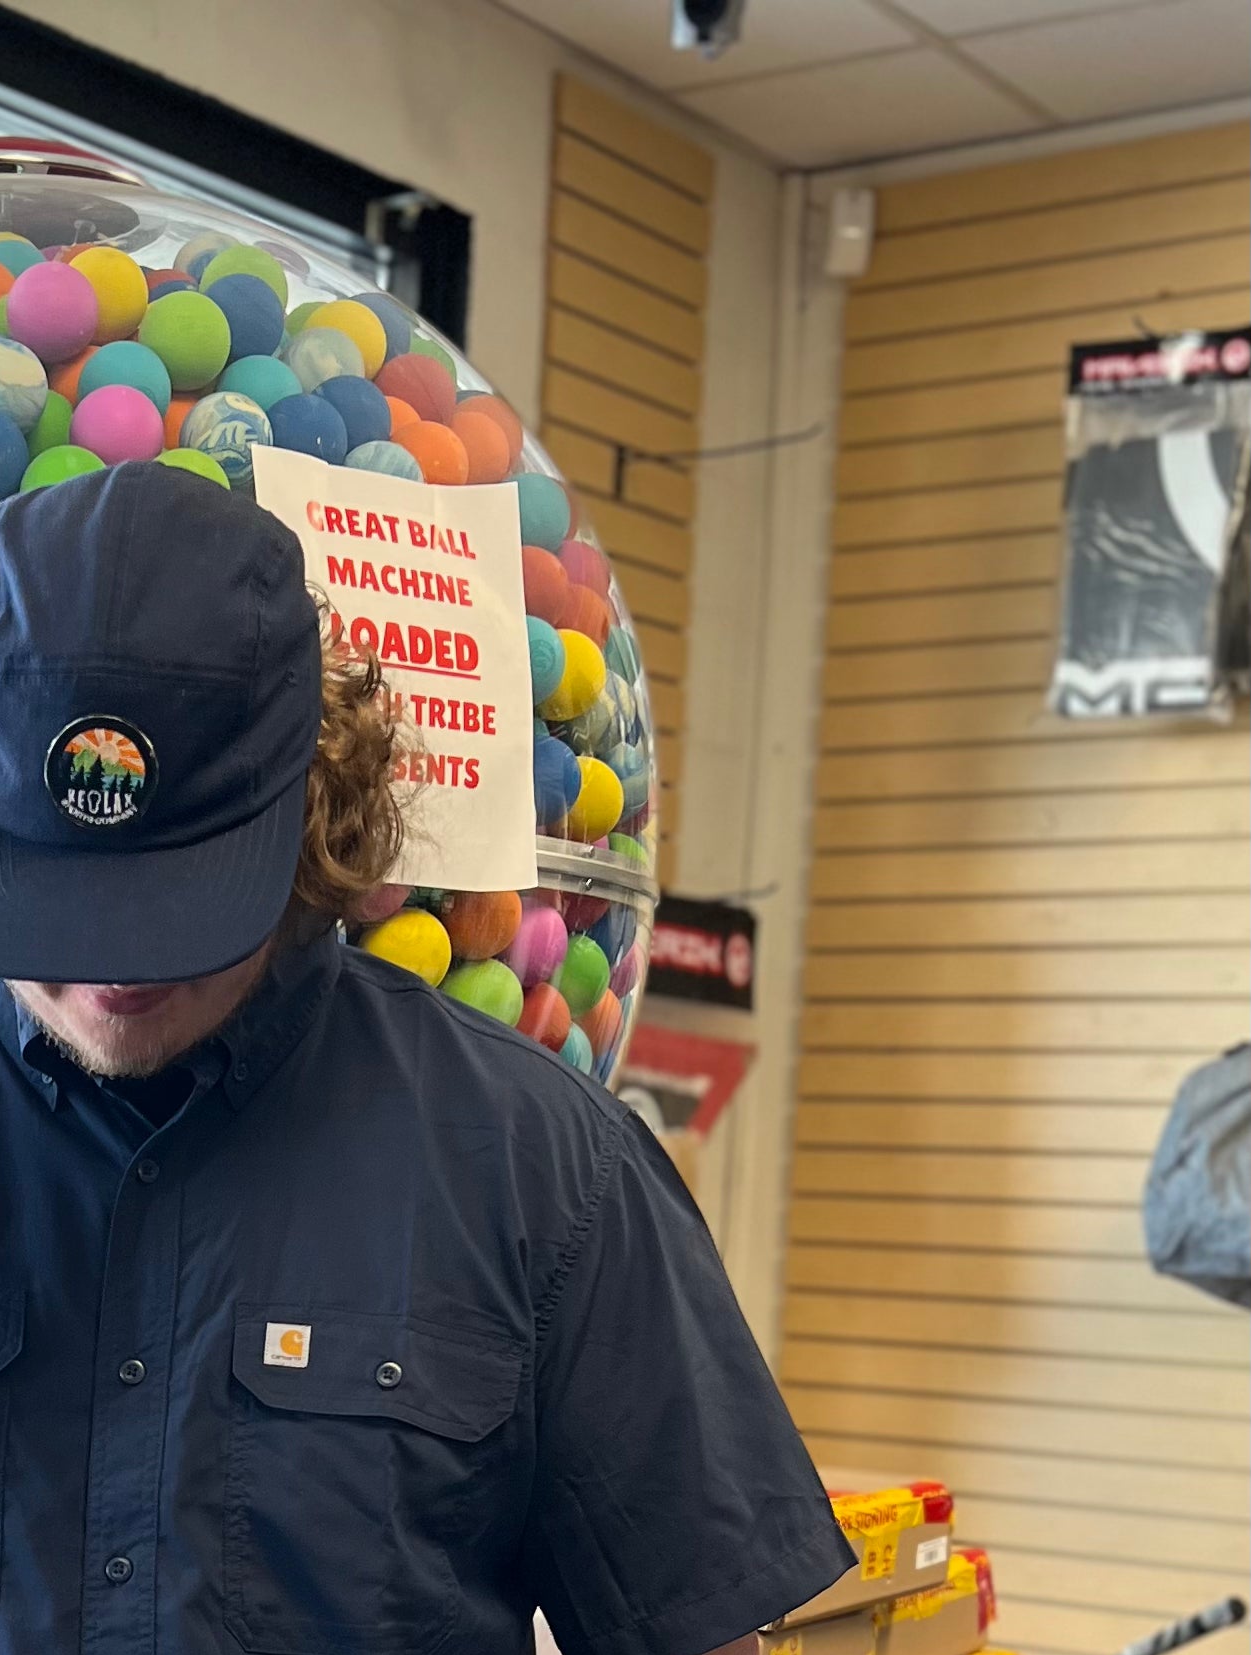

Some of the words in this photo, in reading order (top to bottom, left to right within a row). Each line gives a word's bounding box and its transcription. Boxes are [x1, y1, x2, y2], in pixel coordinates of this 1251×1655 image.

[306, 500, 399, 543] GREAT
[407, 519, 476, 560] BALL
[327, 555, 473, 607] MACHINE
[330, 612, 479, 671] LOADED
[410, 694, 496, 735] TRIBE
